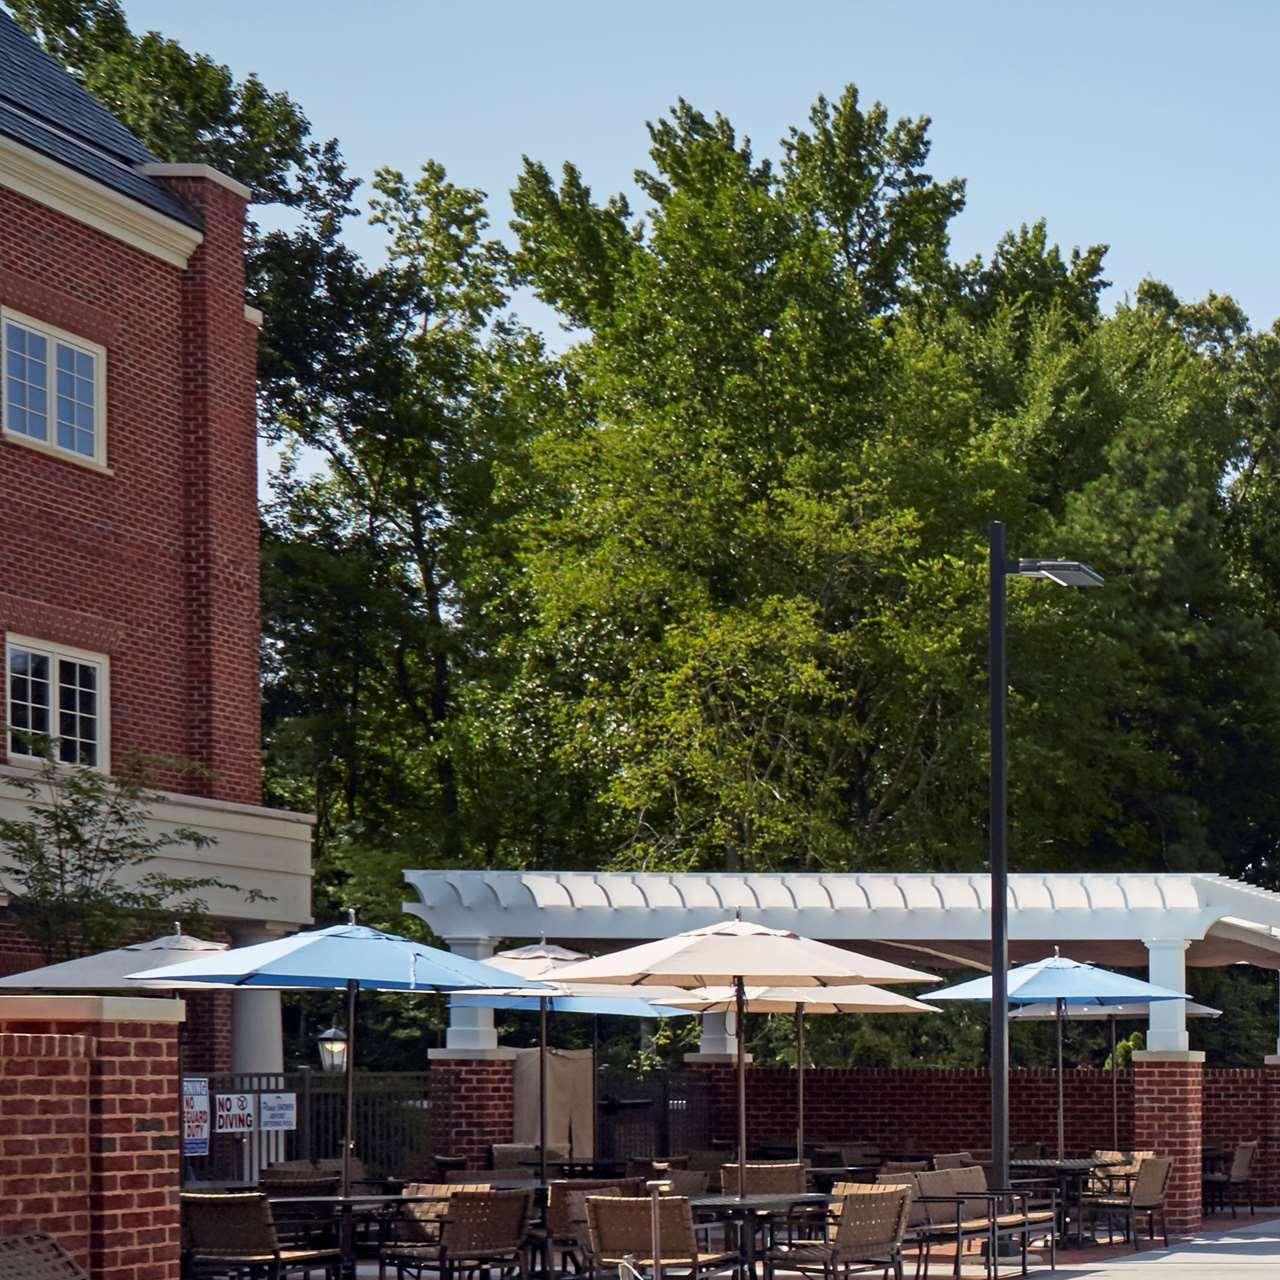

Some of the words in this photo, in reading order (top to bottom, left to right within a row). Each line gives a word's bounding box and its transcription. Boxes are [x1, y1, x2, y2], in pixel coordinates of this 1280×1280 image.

[185, 1097, 194, 1110] NO
[218, 1097, 232, 1113] NO
[218, 1113, 253, 1129] DIVING
[187, 1125, 205, 1138] DUTY
